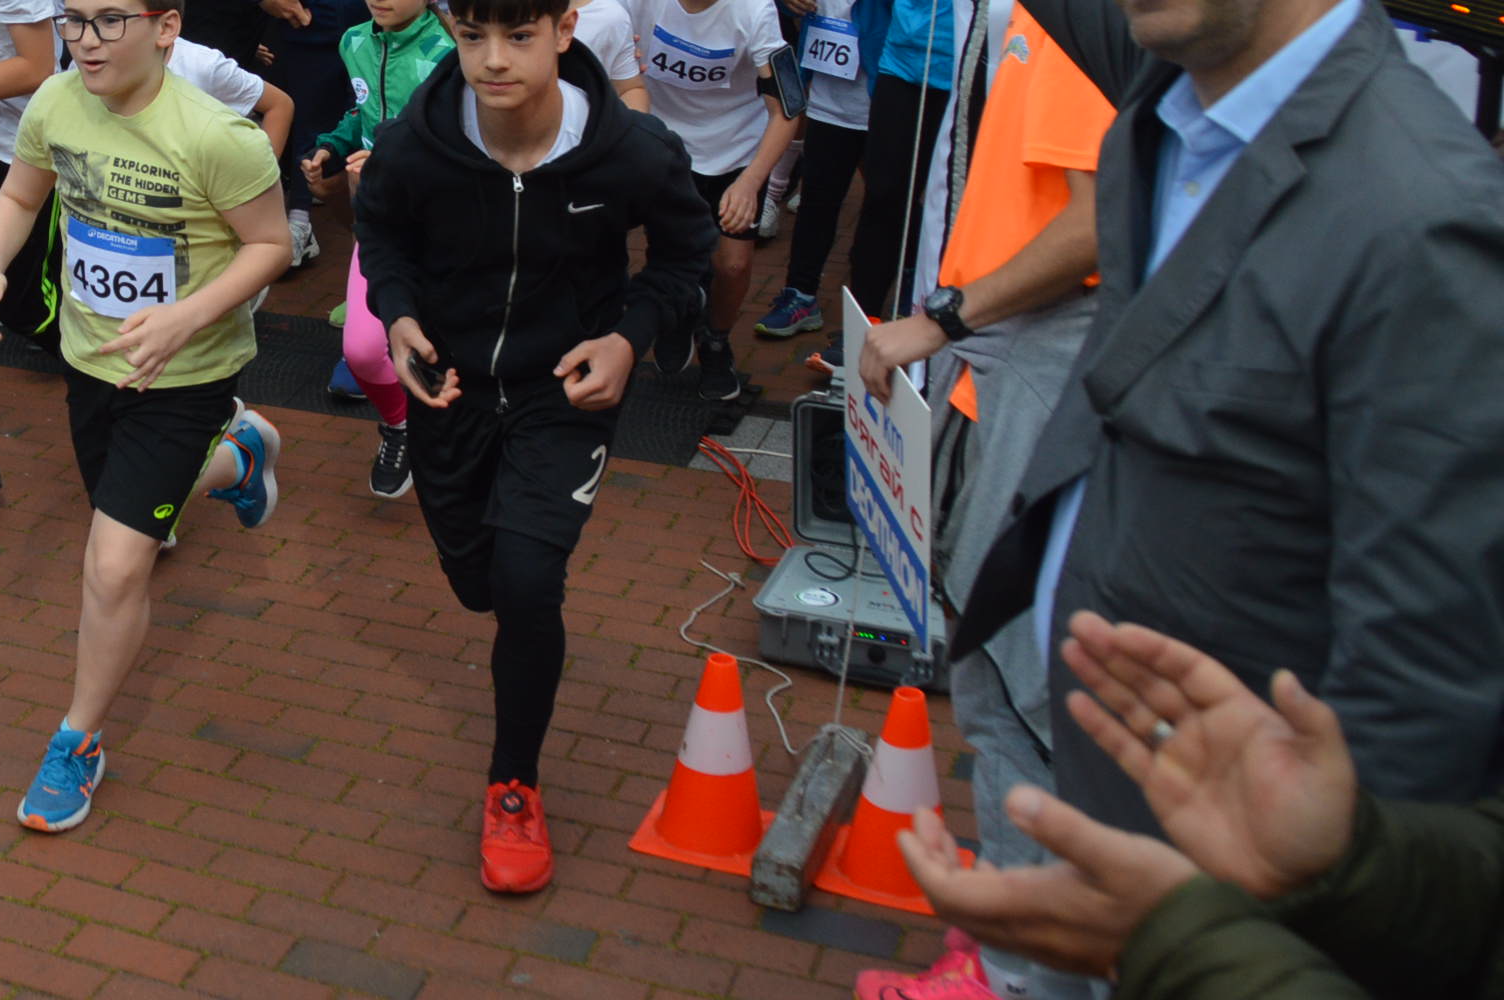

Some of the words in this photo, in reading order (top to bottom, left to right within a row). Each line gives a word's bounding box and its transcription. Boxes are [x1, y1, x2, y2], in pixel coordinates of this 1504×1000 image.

[809, 39, 851, 66] 4176
[652, 52, 727, 82] 4466
[113, 157, 180, 182] EXPLORING
[108, 187, 147, 206] GEMS
[110, 172, 132, 186] THE
[135, 177, 179, 195] HIDDEN
[96, 231, 138, 246] DECATHLON
[73, 258, 168, 304] 4364
[849, 456, 926, 626] DECATHLON
